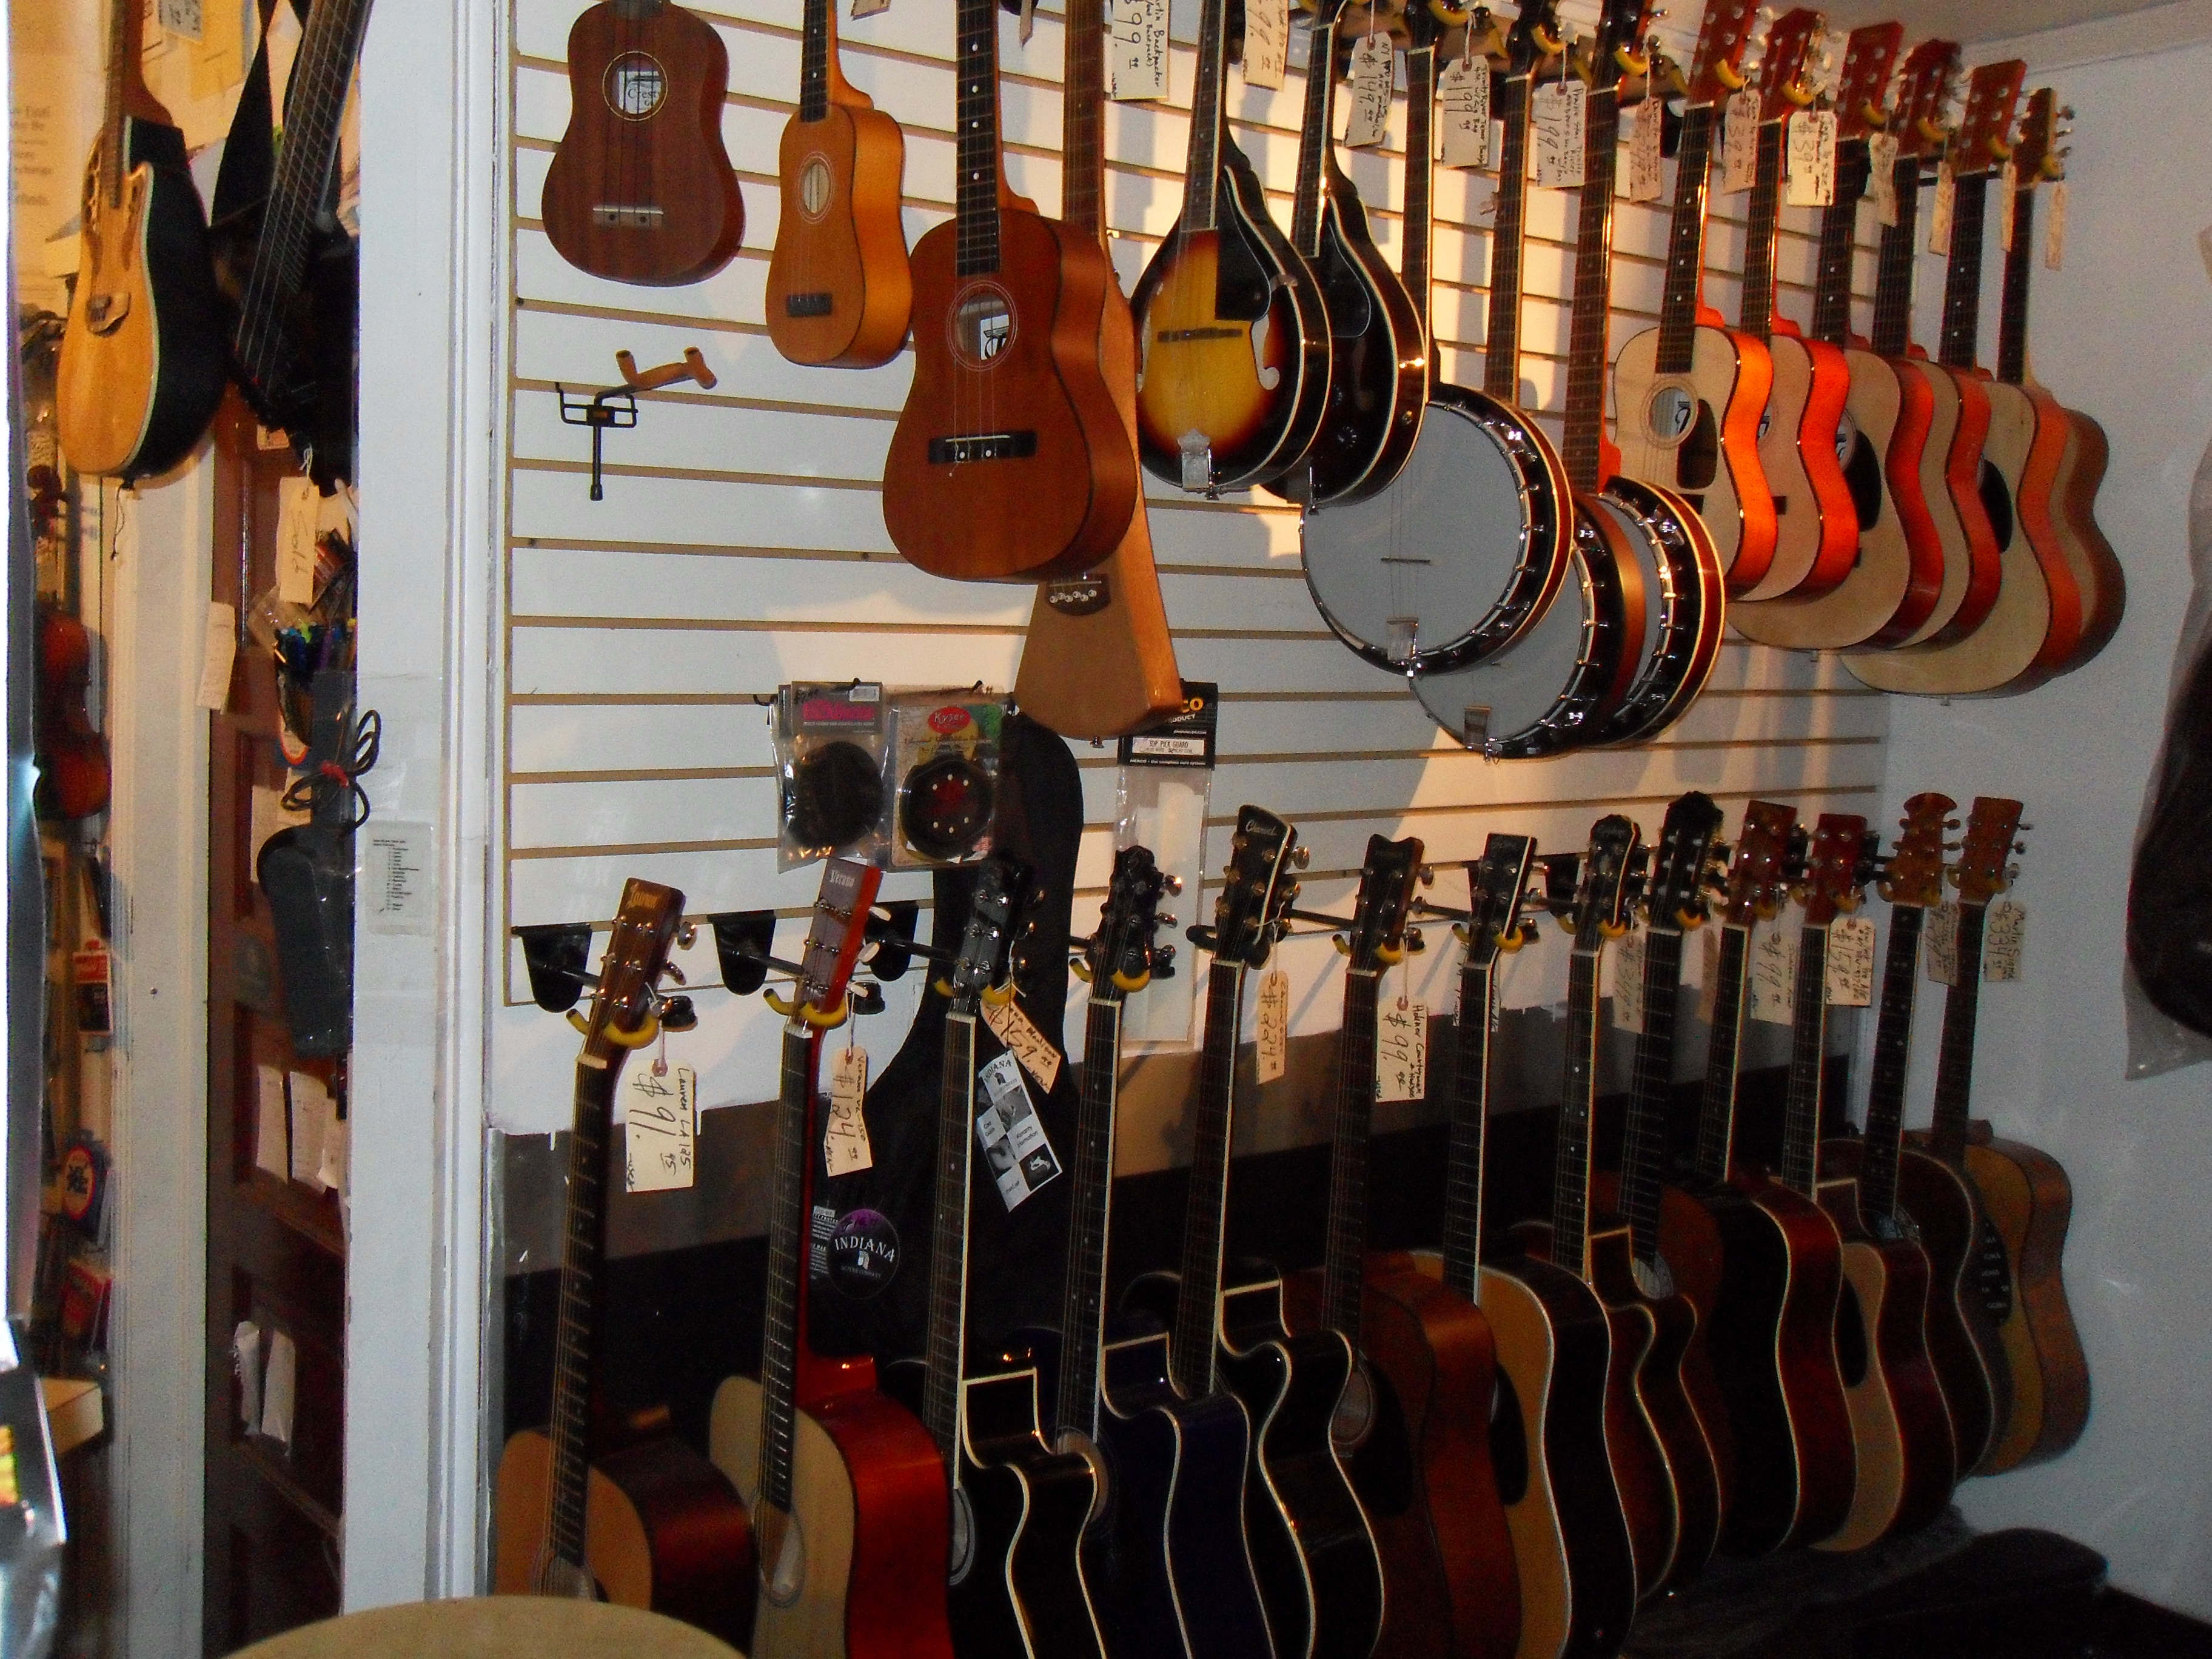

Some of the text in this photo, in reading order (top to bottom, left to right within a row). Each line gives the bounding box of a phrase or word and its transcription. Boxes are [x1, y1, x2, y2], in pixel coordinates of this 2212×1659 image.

[1153, 30, 1165, 87] Backpacker
[934, 711, 964, 724] Kyser
[984, 1059, 1012, 1082] INDIANA
[678, 1068, 690, 1111] Lauren
[834, 1236, 895, 1263] INDIANA
